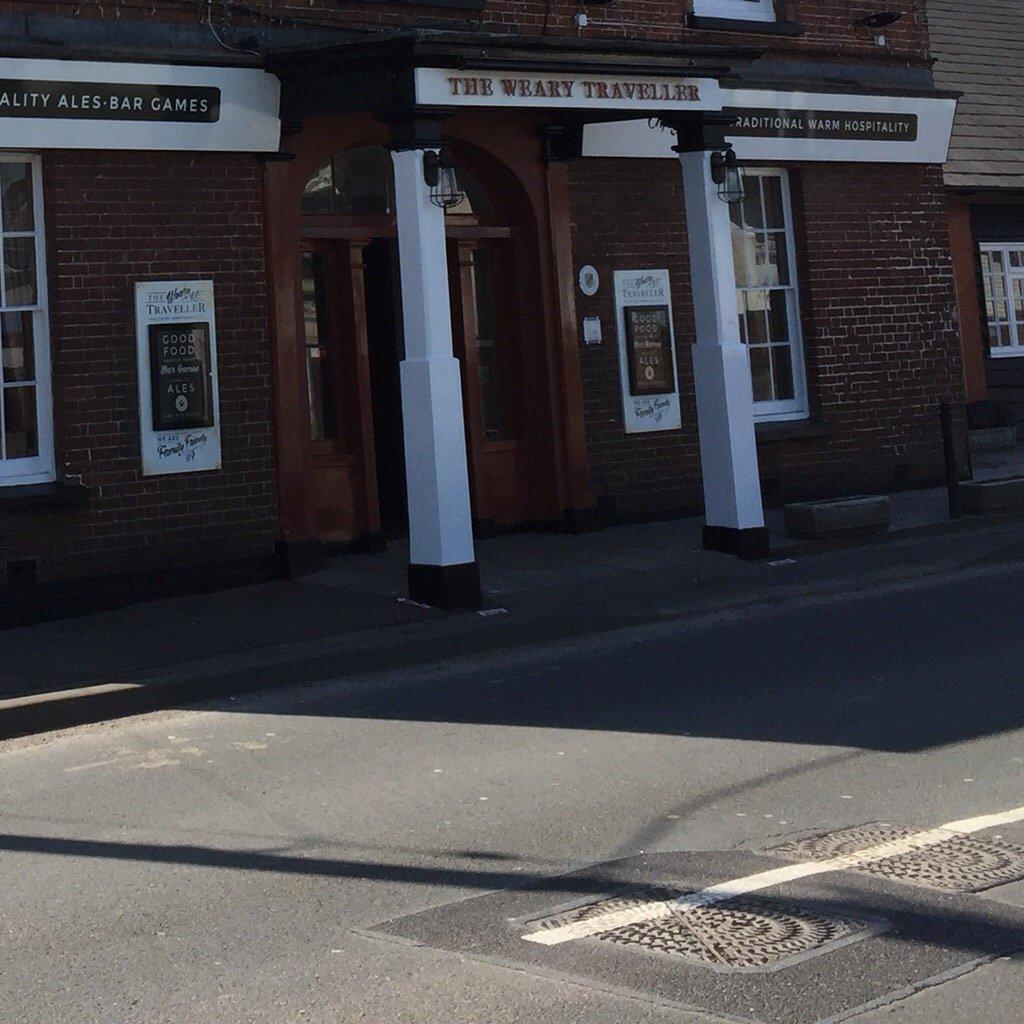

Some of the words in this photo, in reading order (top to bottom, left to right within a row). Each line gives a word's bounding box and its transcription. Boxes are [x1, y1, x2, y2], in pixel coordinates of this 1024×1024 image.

[448, 77, 494, 97] THE
[500, 78, 575, 98] WEARY
[581, 79, 702, 102] TRAVELLER
[151, 97, 209, 113] GAMES
[729, 116, 804, 130] RADITIONAL
[807, 118, 840, 131] WARM
[844, 120, 910, 133] HOSPITALITY
[146, 302, 206, 315] TRAVELLER
[162, 333, 195, 344] GOOD
[163, 345, 195, 356] FOOD
[167, 382, 195, 394] ALES
